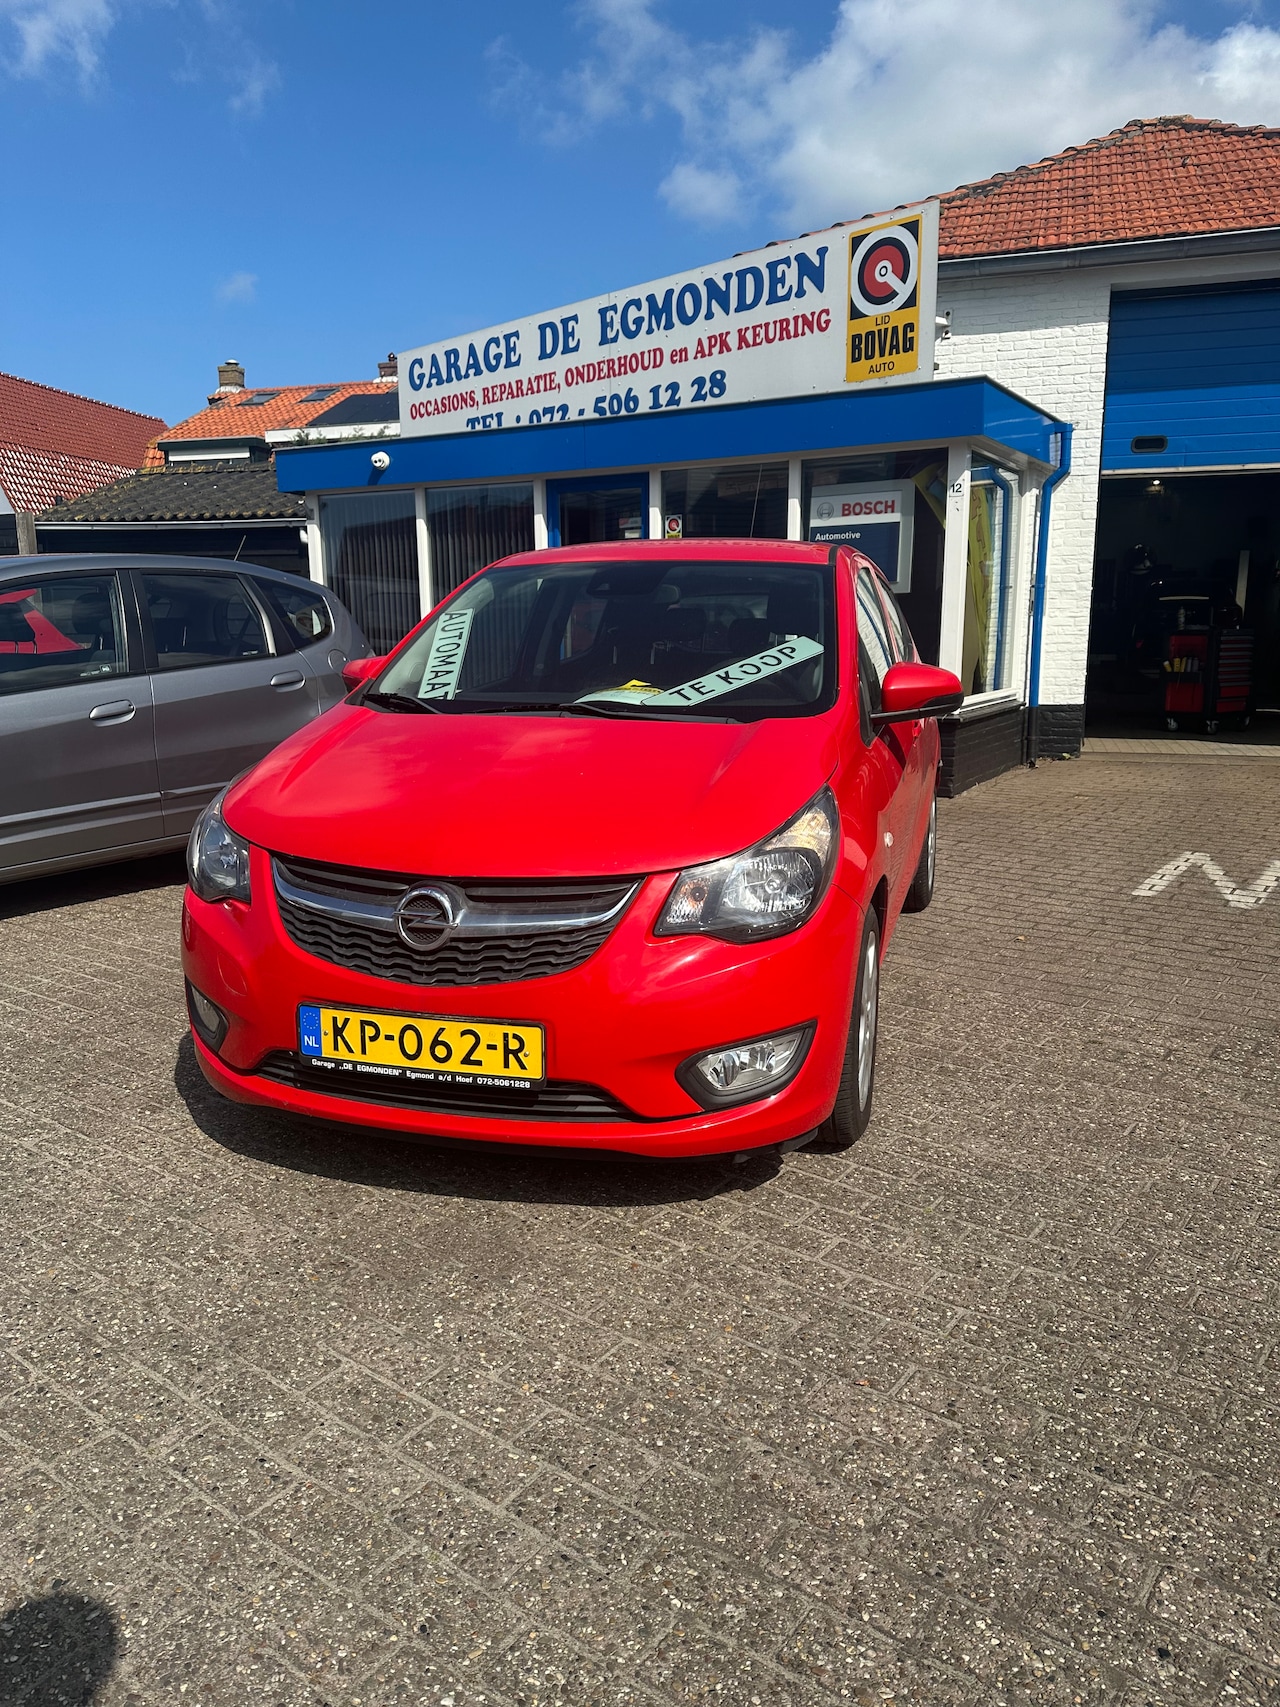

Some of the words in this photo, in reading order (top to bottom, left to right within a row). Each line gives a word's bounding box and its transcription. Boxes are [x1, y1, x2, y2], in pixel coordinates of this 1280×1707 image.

[409, 330, 522, 392] GARAGE
[537, 314, 581, 361] DE
[597, 246, 829, 347] EGMONDEN
[875, 314, 891, 326] LID
[851, 322, 915, 364] BOVAG
[410, 390, 479, 421] OCCASIONS,
[482, 371, 561, 405] REPARATIE,
[564, 347, 665, 387] ONDERHOUD
[670, 346, 689, 365] en
[693, 331, 732, 360] APK
[737, 308, 832, 351] KEURING
[868, 361, 895, 375] AUTO
[593, 387, 640, 417] 506
[649, 384, 681, 410] 12
[690, 370, 727, 402] 28
[951, 483, 962, 493] 12
[841, 500, 896, 517] BOSCH
[815, 531, 861, 541] Automotive
[668, 681, 716, 701] TE
[715, 646, 797, 685] KOOP
[304, 1034, 320, 1048] NL
[331, 1015, 528, 1071] KP-062-R
[311, 1059, 335, 1069] Garage
[406, 1070, 434, 1079] Egmond
[438, 1073, 452, 1082] a/d
[456, 1075, 473, 1084] Hoef
[477, 1077, 531, 1088] 072-5061228
